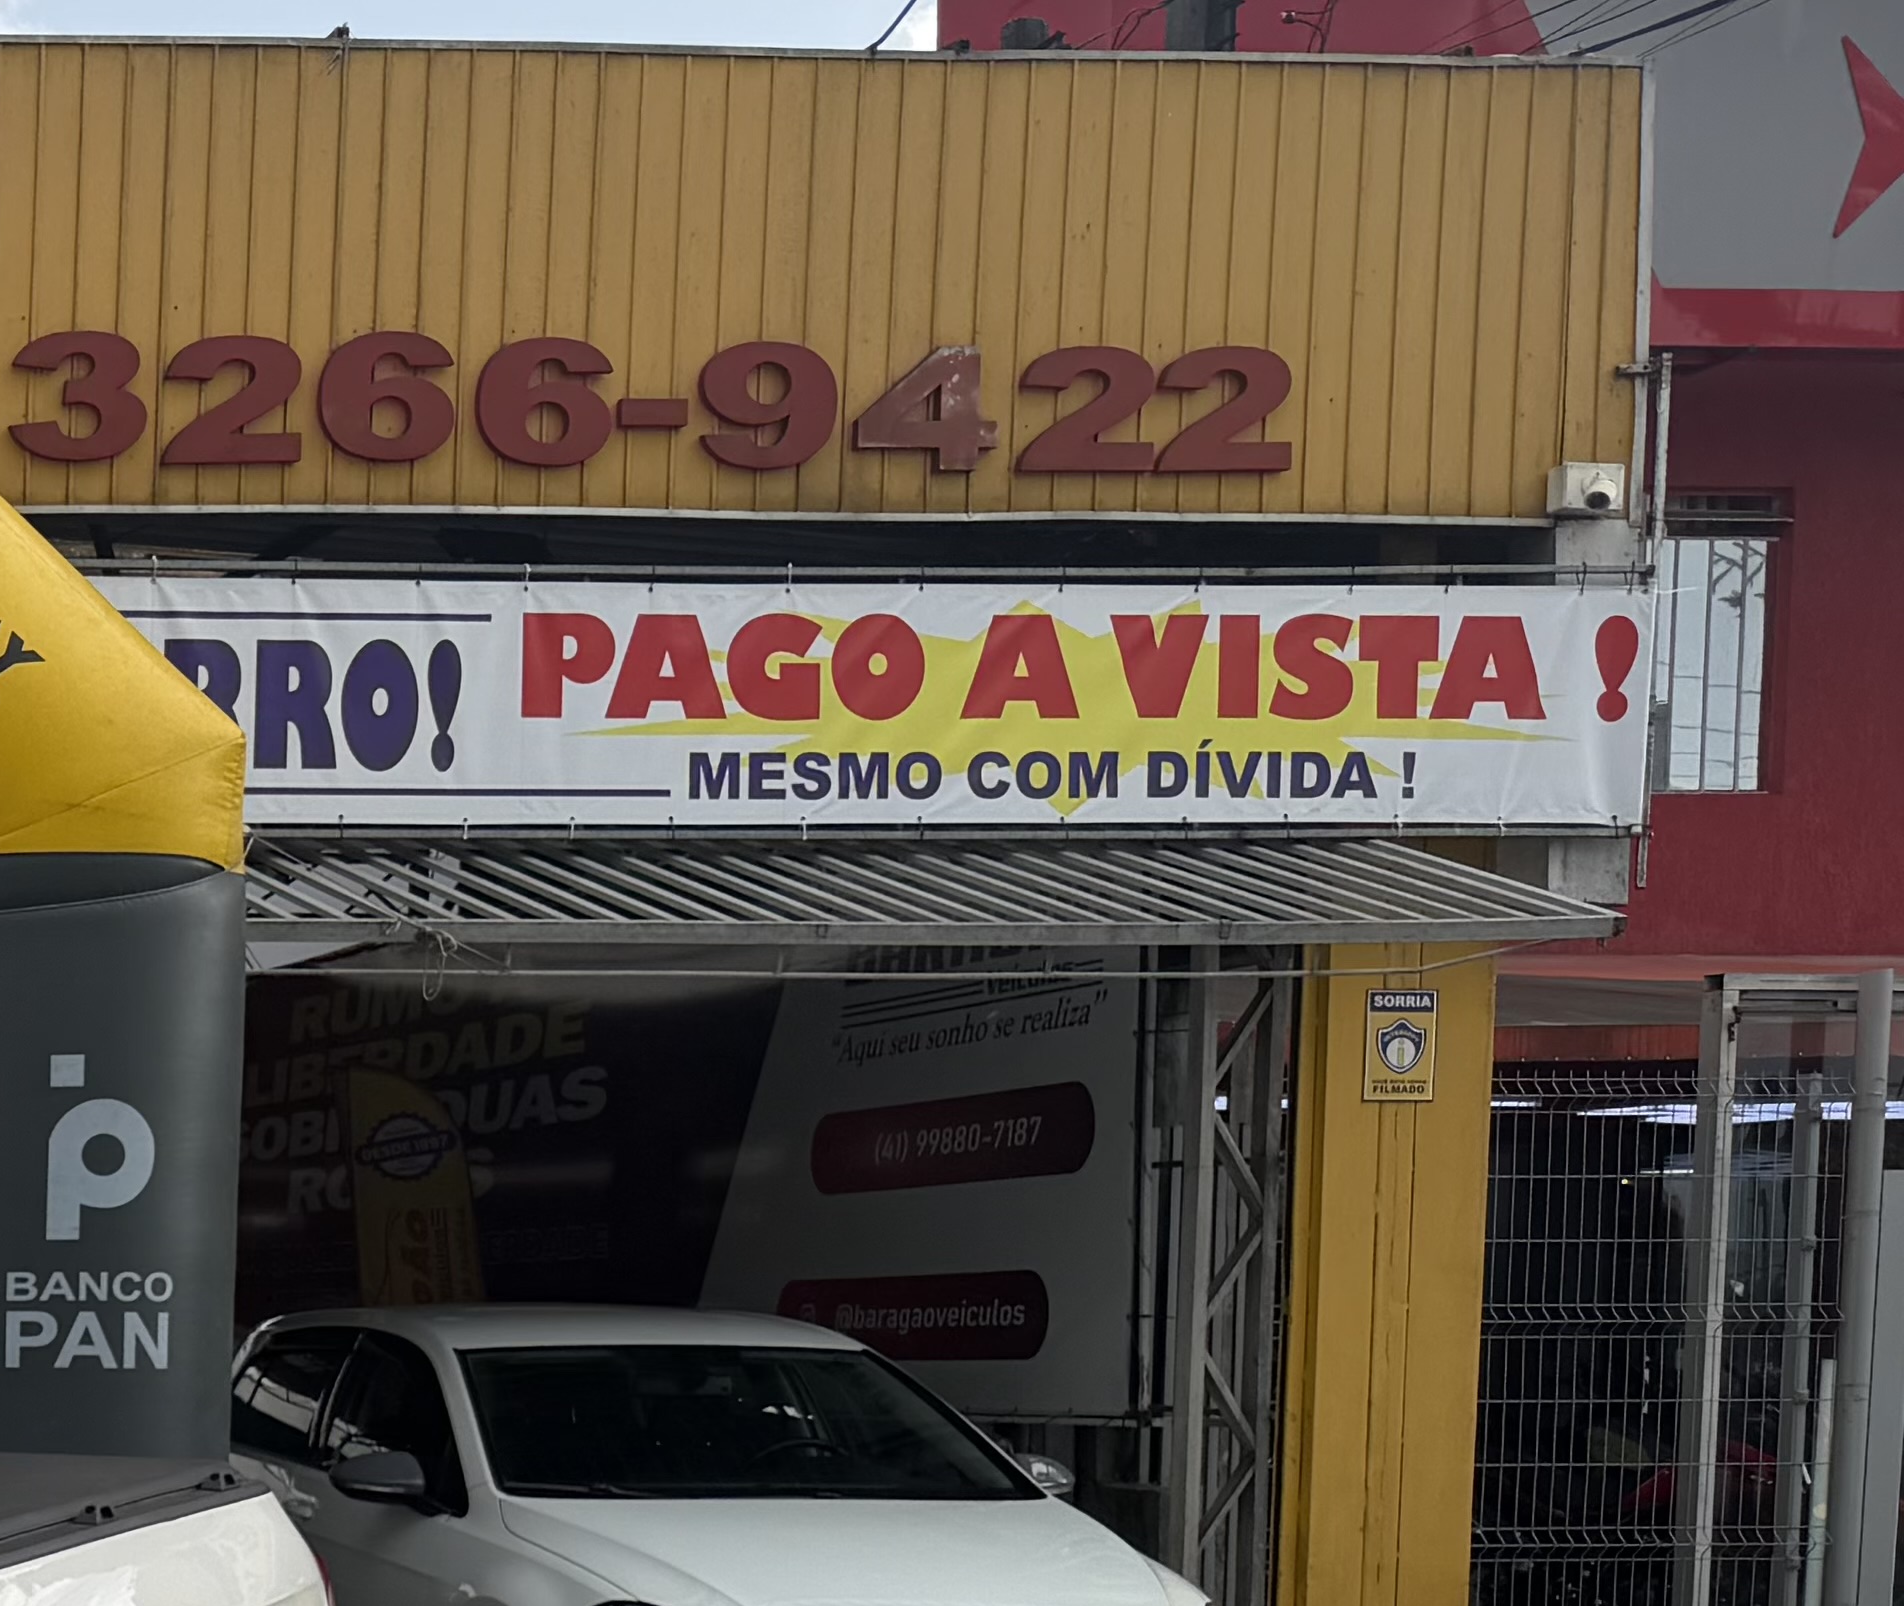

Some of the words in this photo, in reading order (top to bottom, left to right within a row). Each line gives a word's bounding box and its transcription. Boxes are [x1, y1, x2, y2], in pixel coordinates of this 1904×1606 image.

[6, 330, 1293, 474] 3266-9422
[521, 612, 924, 722] PAGO
[1109, 612, 1547, 721] VISTA
[1594, 614, 1639, 723] !
[688, 751, 942, 801] MESMO
[967, 749, 1120, 800] COM
[1146, 738, 1379, 801] DÍVIDA
[1401, 751, 1417, 799] !
[1373, 994, 1432, 1008] SORRIA
[889, 1035, 921, 1056] seu
[926, 1014, 988, 1050] sonho
[915, 1115, 1044, 1160] 99880-7187
[4, 1270, 174, 1302] BANCO
[3, 1309, 170, 1370] PAN
[835, 1299, 1027, 1335] @baragaoveiculos
